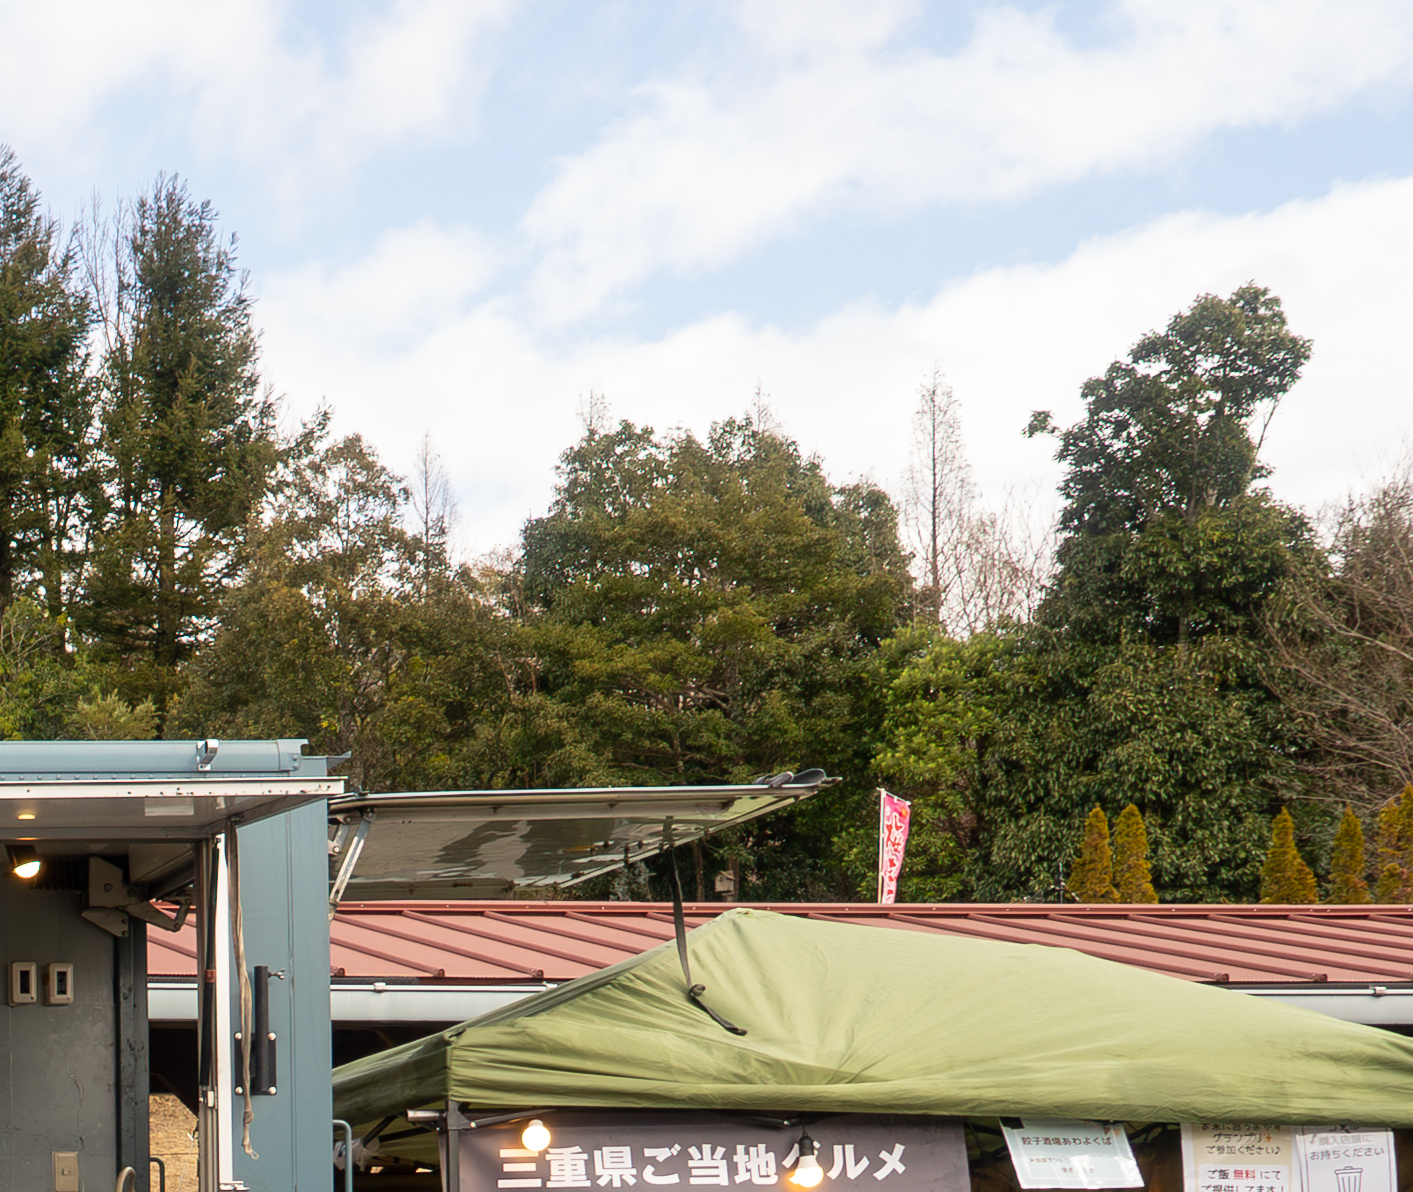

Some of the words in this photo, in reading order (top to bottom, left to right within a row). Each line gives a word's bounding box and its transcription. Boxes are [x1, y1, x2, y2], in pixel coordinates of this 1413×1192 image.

[1310, 1147, 1385, 1160] お持ちください
[1207, 1169, 1229, 1180] ご飯
[1233, 1169, 1256, 1180] 無料
[1260, 1170, 1281, 1180] にて
